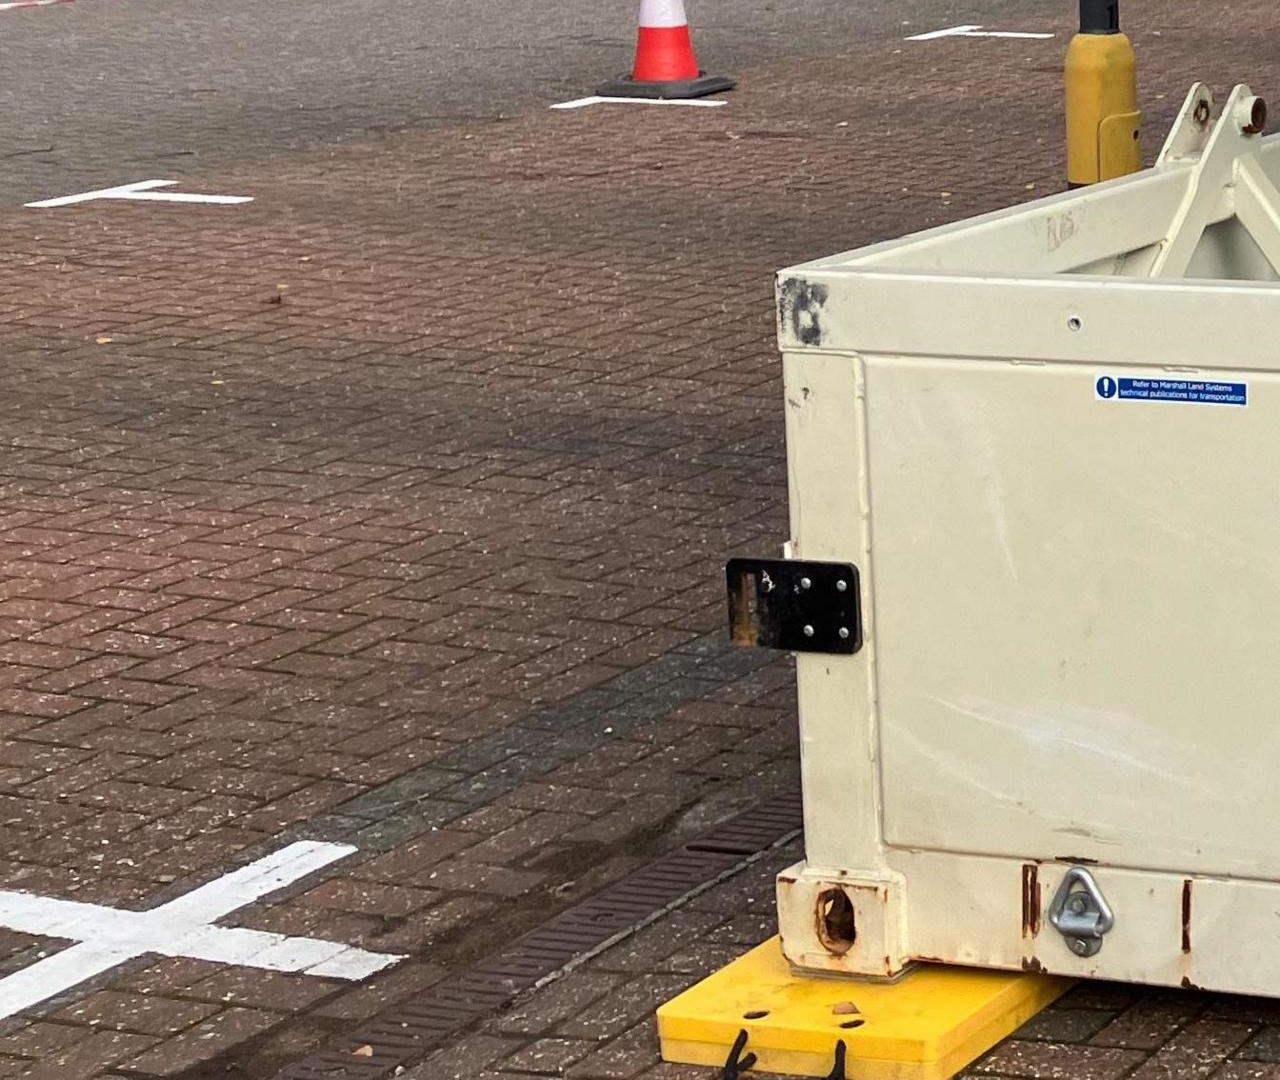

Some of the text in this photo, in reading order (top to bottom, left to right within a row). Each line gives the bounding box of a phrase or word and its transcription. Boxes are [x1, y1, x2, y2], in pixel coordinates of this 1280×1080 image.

[1160, 381, 1187, 390] Marshall
[1188, 382, 1204, 391] Land
[1205, 383, 1233, 392] Systems
[1120, 389, 1148, 397] technical
[1149, 390, 1188, 399] publications
[1199, 392, 1245, 402] transportation
